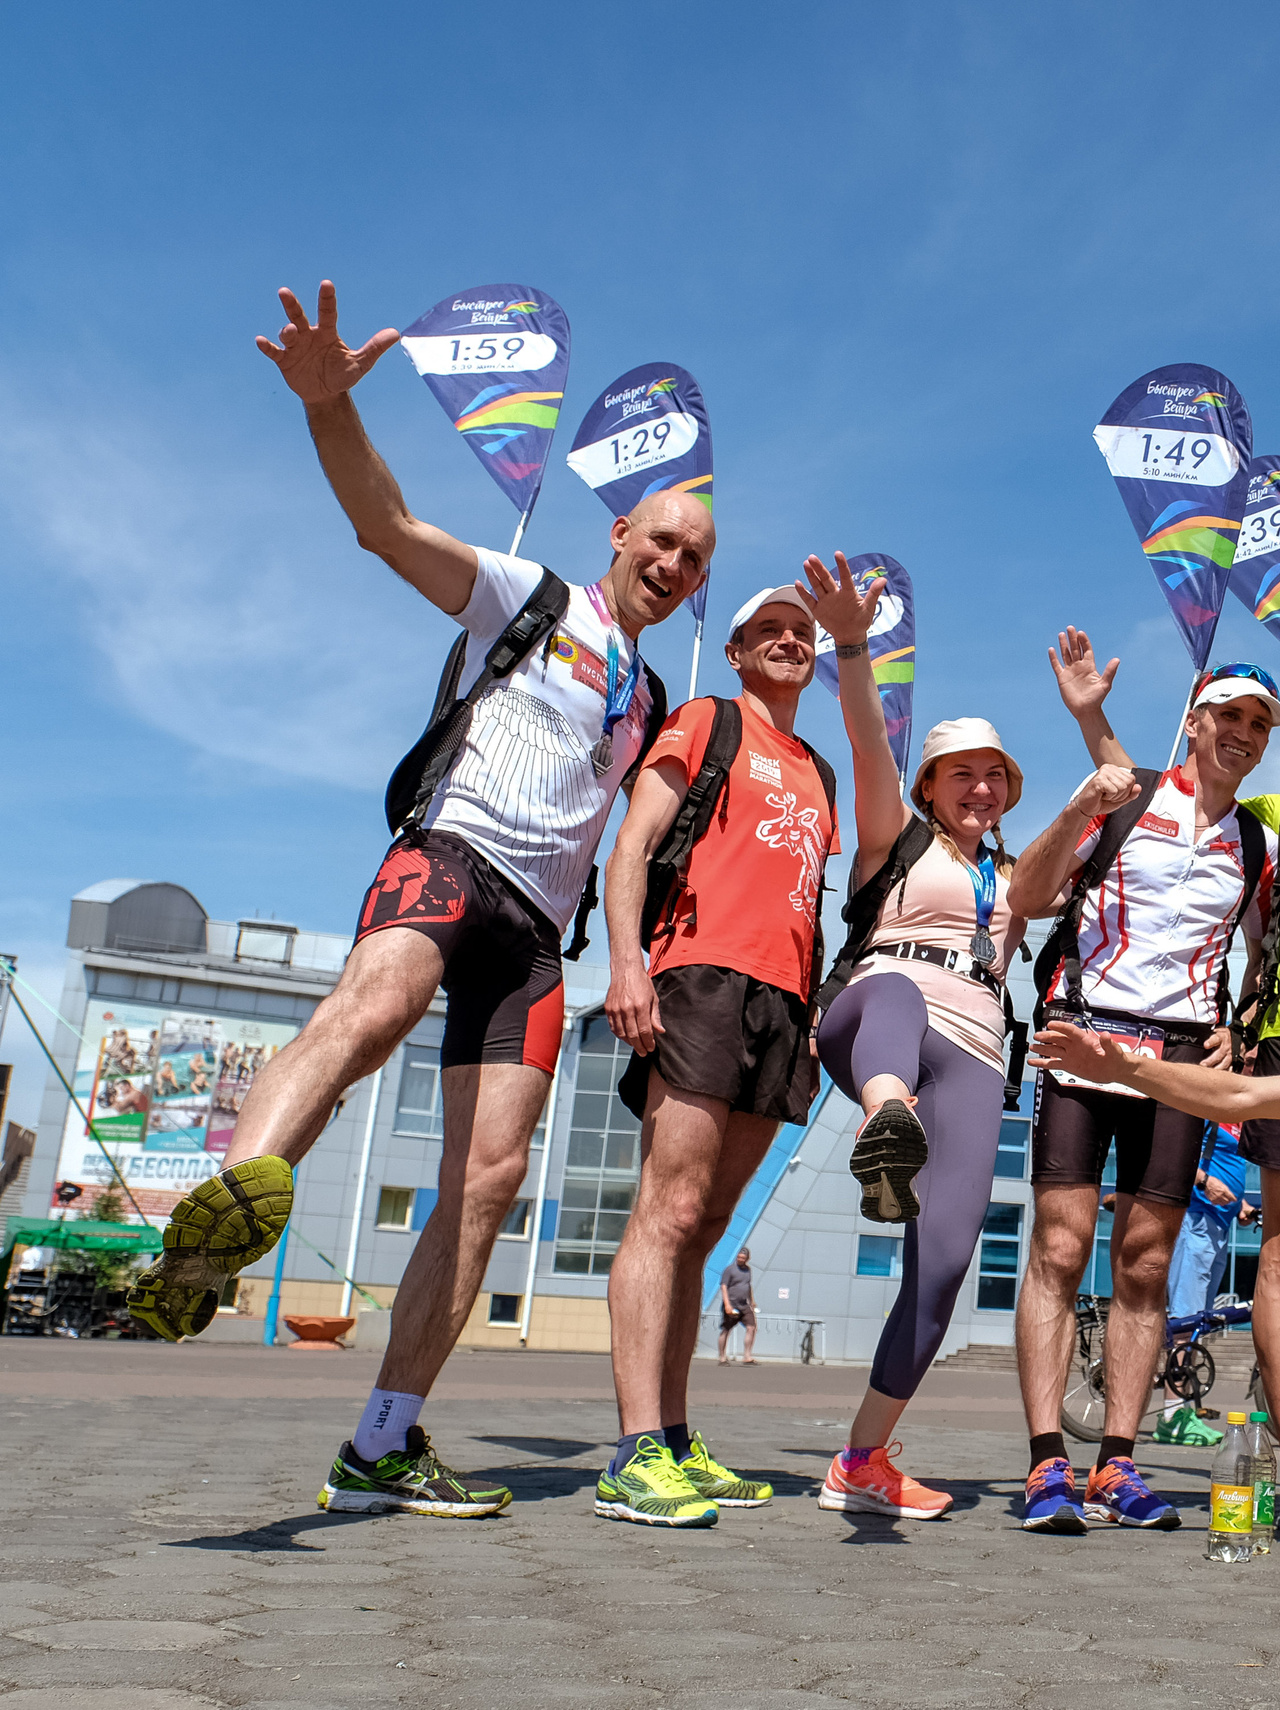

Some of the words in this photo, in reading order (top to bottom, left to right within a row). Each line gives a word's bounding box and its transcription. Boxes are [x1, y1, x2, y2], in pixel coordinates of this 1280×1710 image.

[452, 299, 504, 313] Быстрее
[471, 312, 508, 326] Ветра
[450, 337, 525, 361] 1:59
[604, 385, 647, 409] Быстрее
[1147, 380, 1194, 402] Быстрее
[622, 397, 653, 417] Ветра
[1163, 399, 1198, 420] Ветра
[610, 421, 671, 465] 1:29
[1142, 433, 1211, 469] 1:49
[634, 453, 666, 468] мин/км
[1143, 467, 1160, 476] 5:10
[1163, 471, 1198, 481] мин/км
[748, 750, 780, 768] TOMSK
[749, 772, 783, 790] MARATHON
[130, 1156, 221, 1179] БЕСПЛА
[373, 1398, 393, 1430] SPORT
